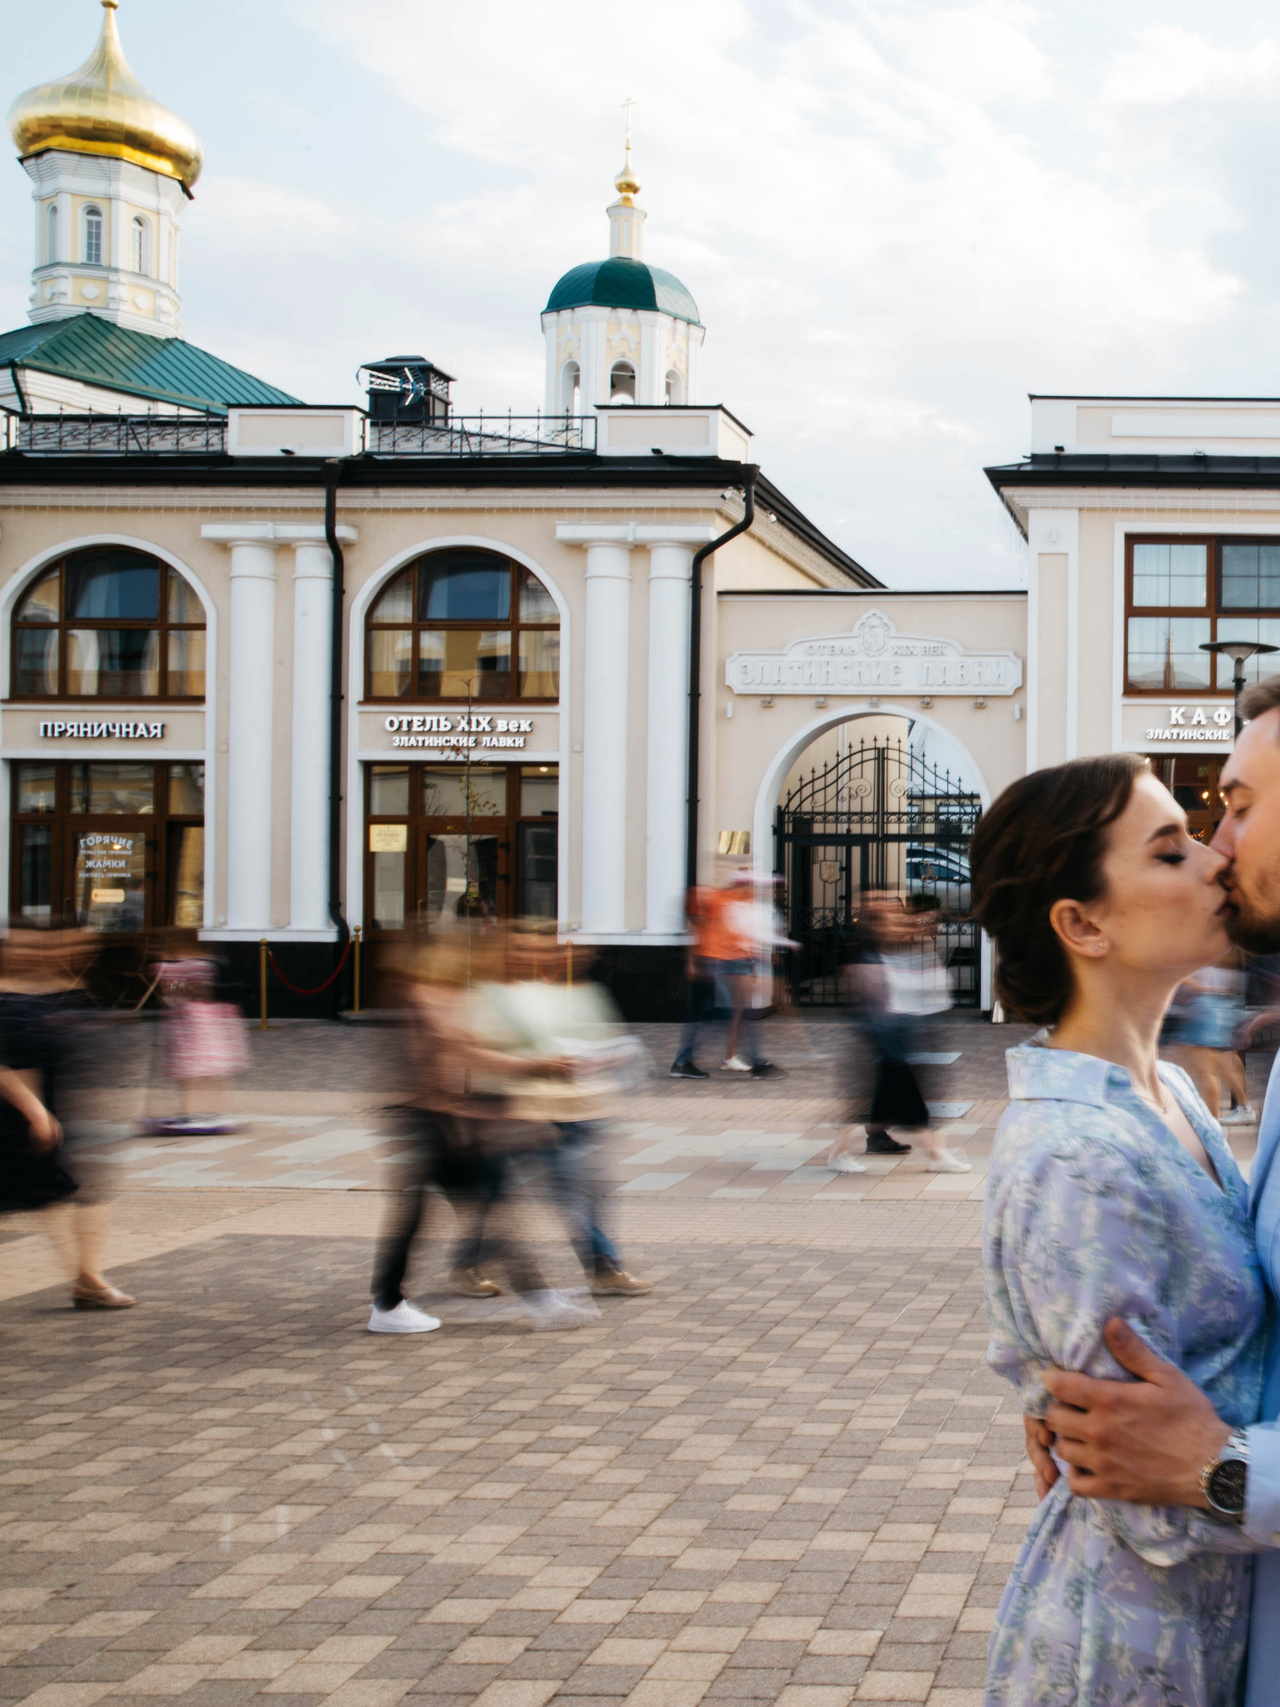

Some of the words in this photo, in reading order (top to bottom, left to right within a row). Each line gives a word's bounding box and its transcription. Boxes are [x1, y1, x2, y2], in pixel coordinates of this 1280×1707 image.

[740, 660, 904, 686] ЗЛАТИНСКИЕ
[920, 660, 1008, 686] ЛАВКИ
[39, 721, 163, 738] ПРЯНИЧНАЯ
[385, 716, 452, 732] ОТЕЛЬ
[1146, 728, 1230, 740] ЗЛАТИНСКИЕ
[392, 736, 477, 747] ЗЛАТИНСКИЕ
[482, 736, 525, 747] ЛАВКИ
[80, 835, 134, 849] ГОРЯЧИЕ
[86, 860, 127, 868] ЖАМКИ
